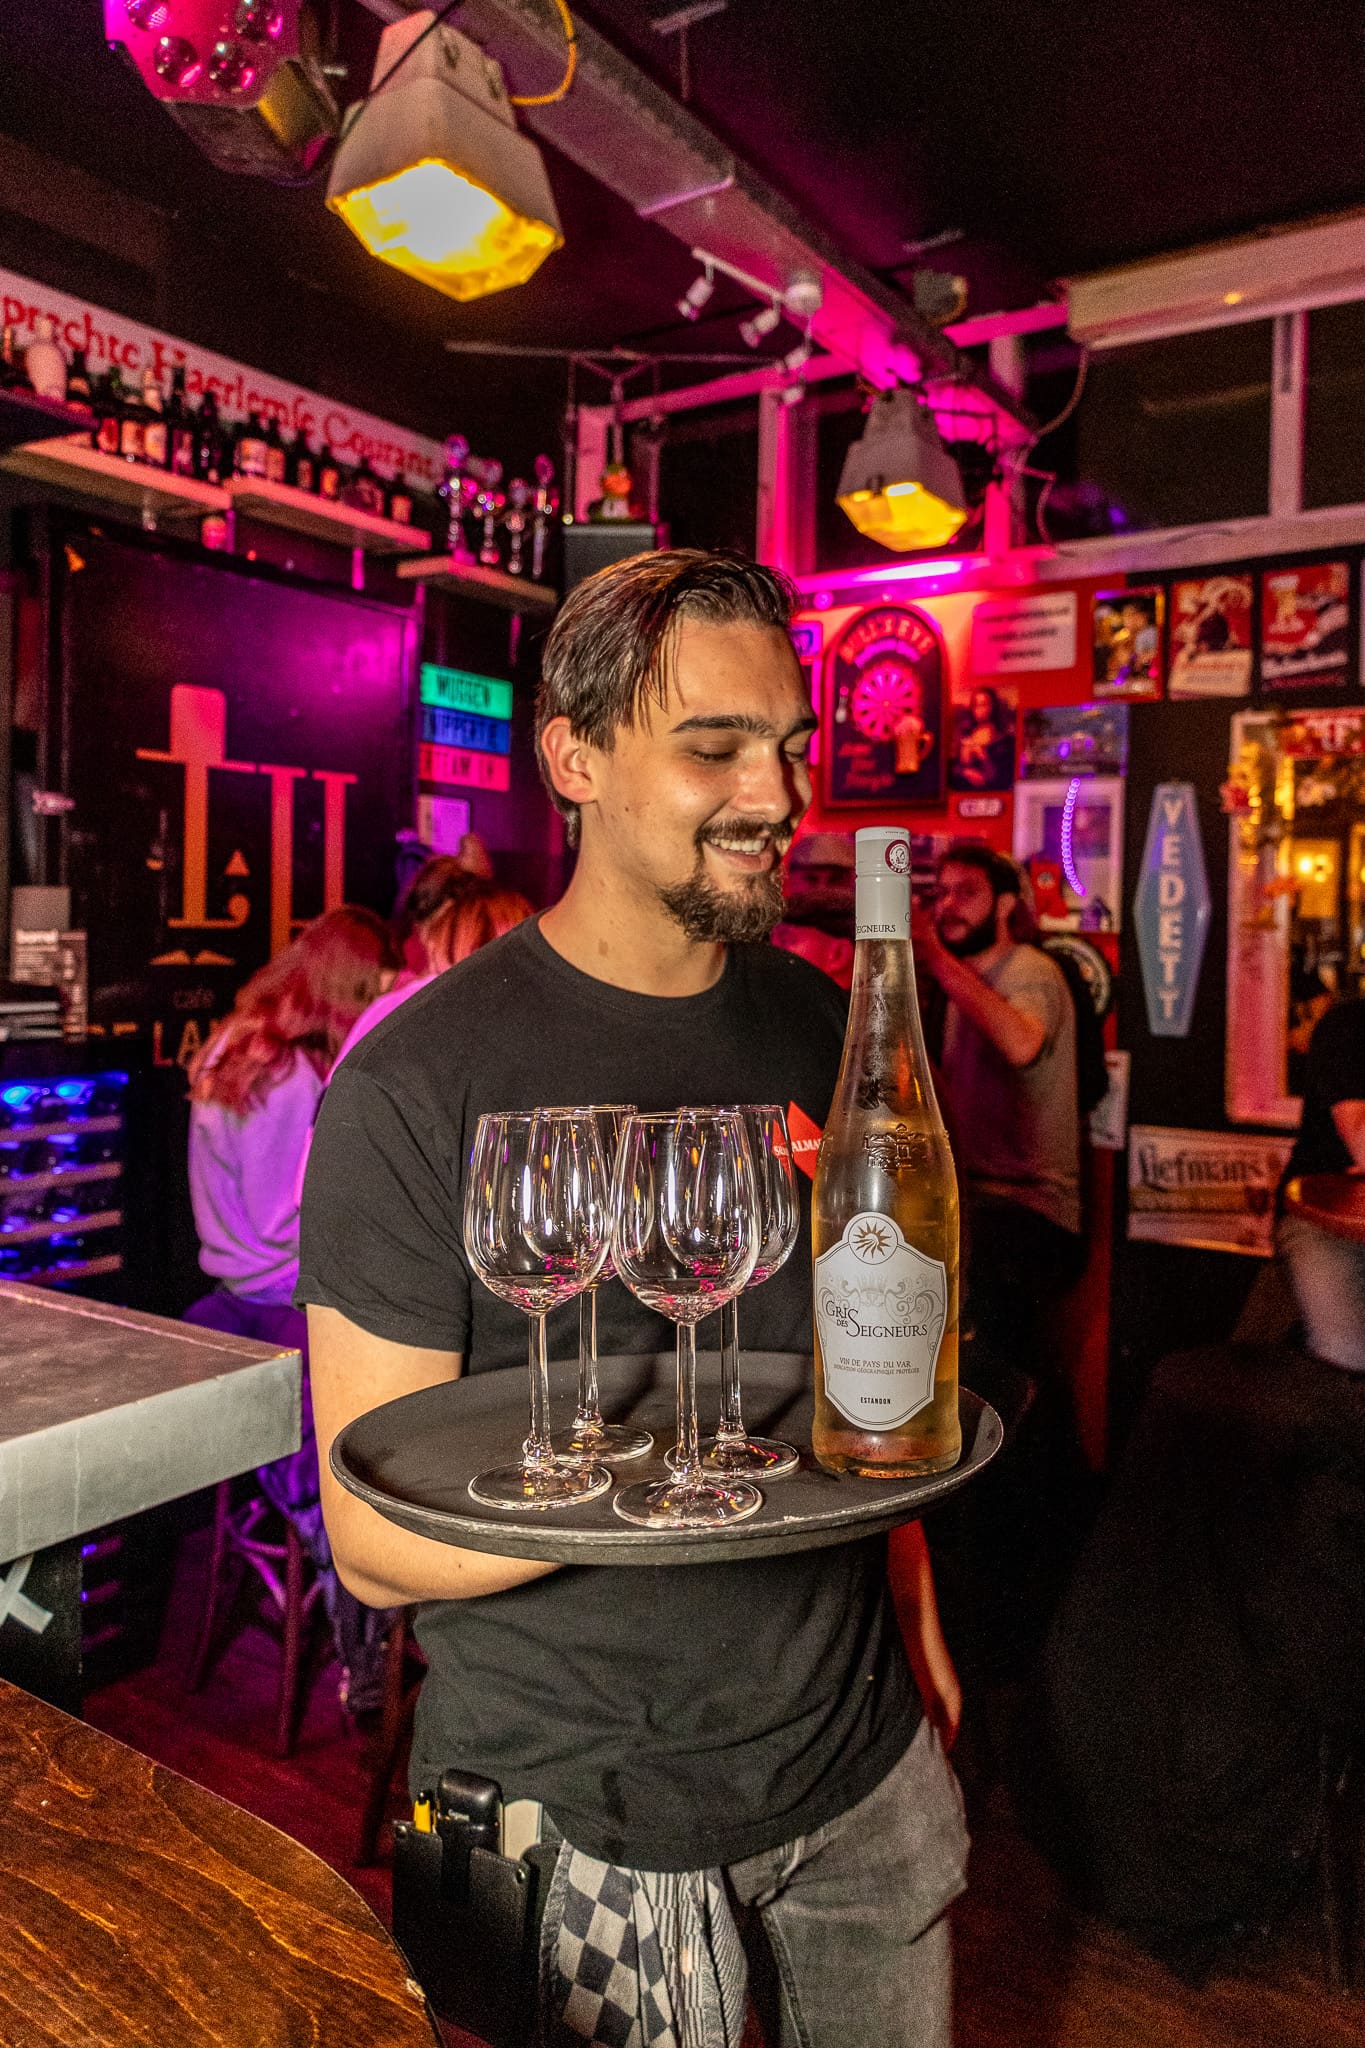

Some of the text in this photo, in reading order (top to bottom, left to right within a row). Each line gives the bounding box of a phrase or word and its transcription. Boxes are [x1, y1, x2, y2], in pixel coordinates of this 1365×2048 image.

[1159, 800, 1186, 1020] VEDETT
[836, 1319, 849, 1328] DES
[839, 1356, 850, 1366] VIN
[851, 1359, 861, 1367] DE
[862, 1360, 881, 1368] PAYS
